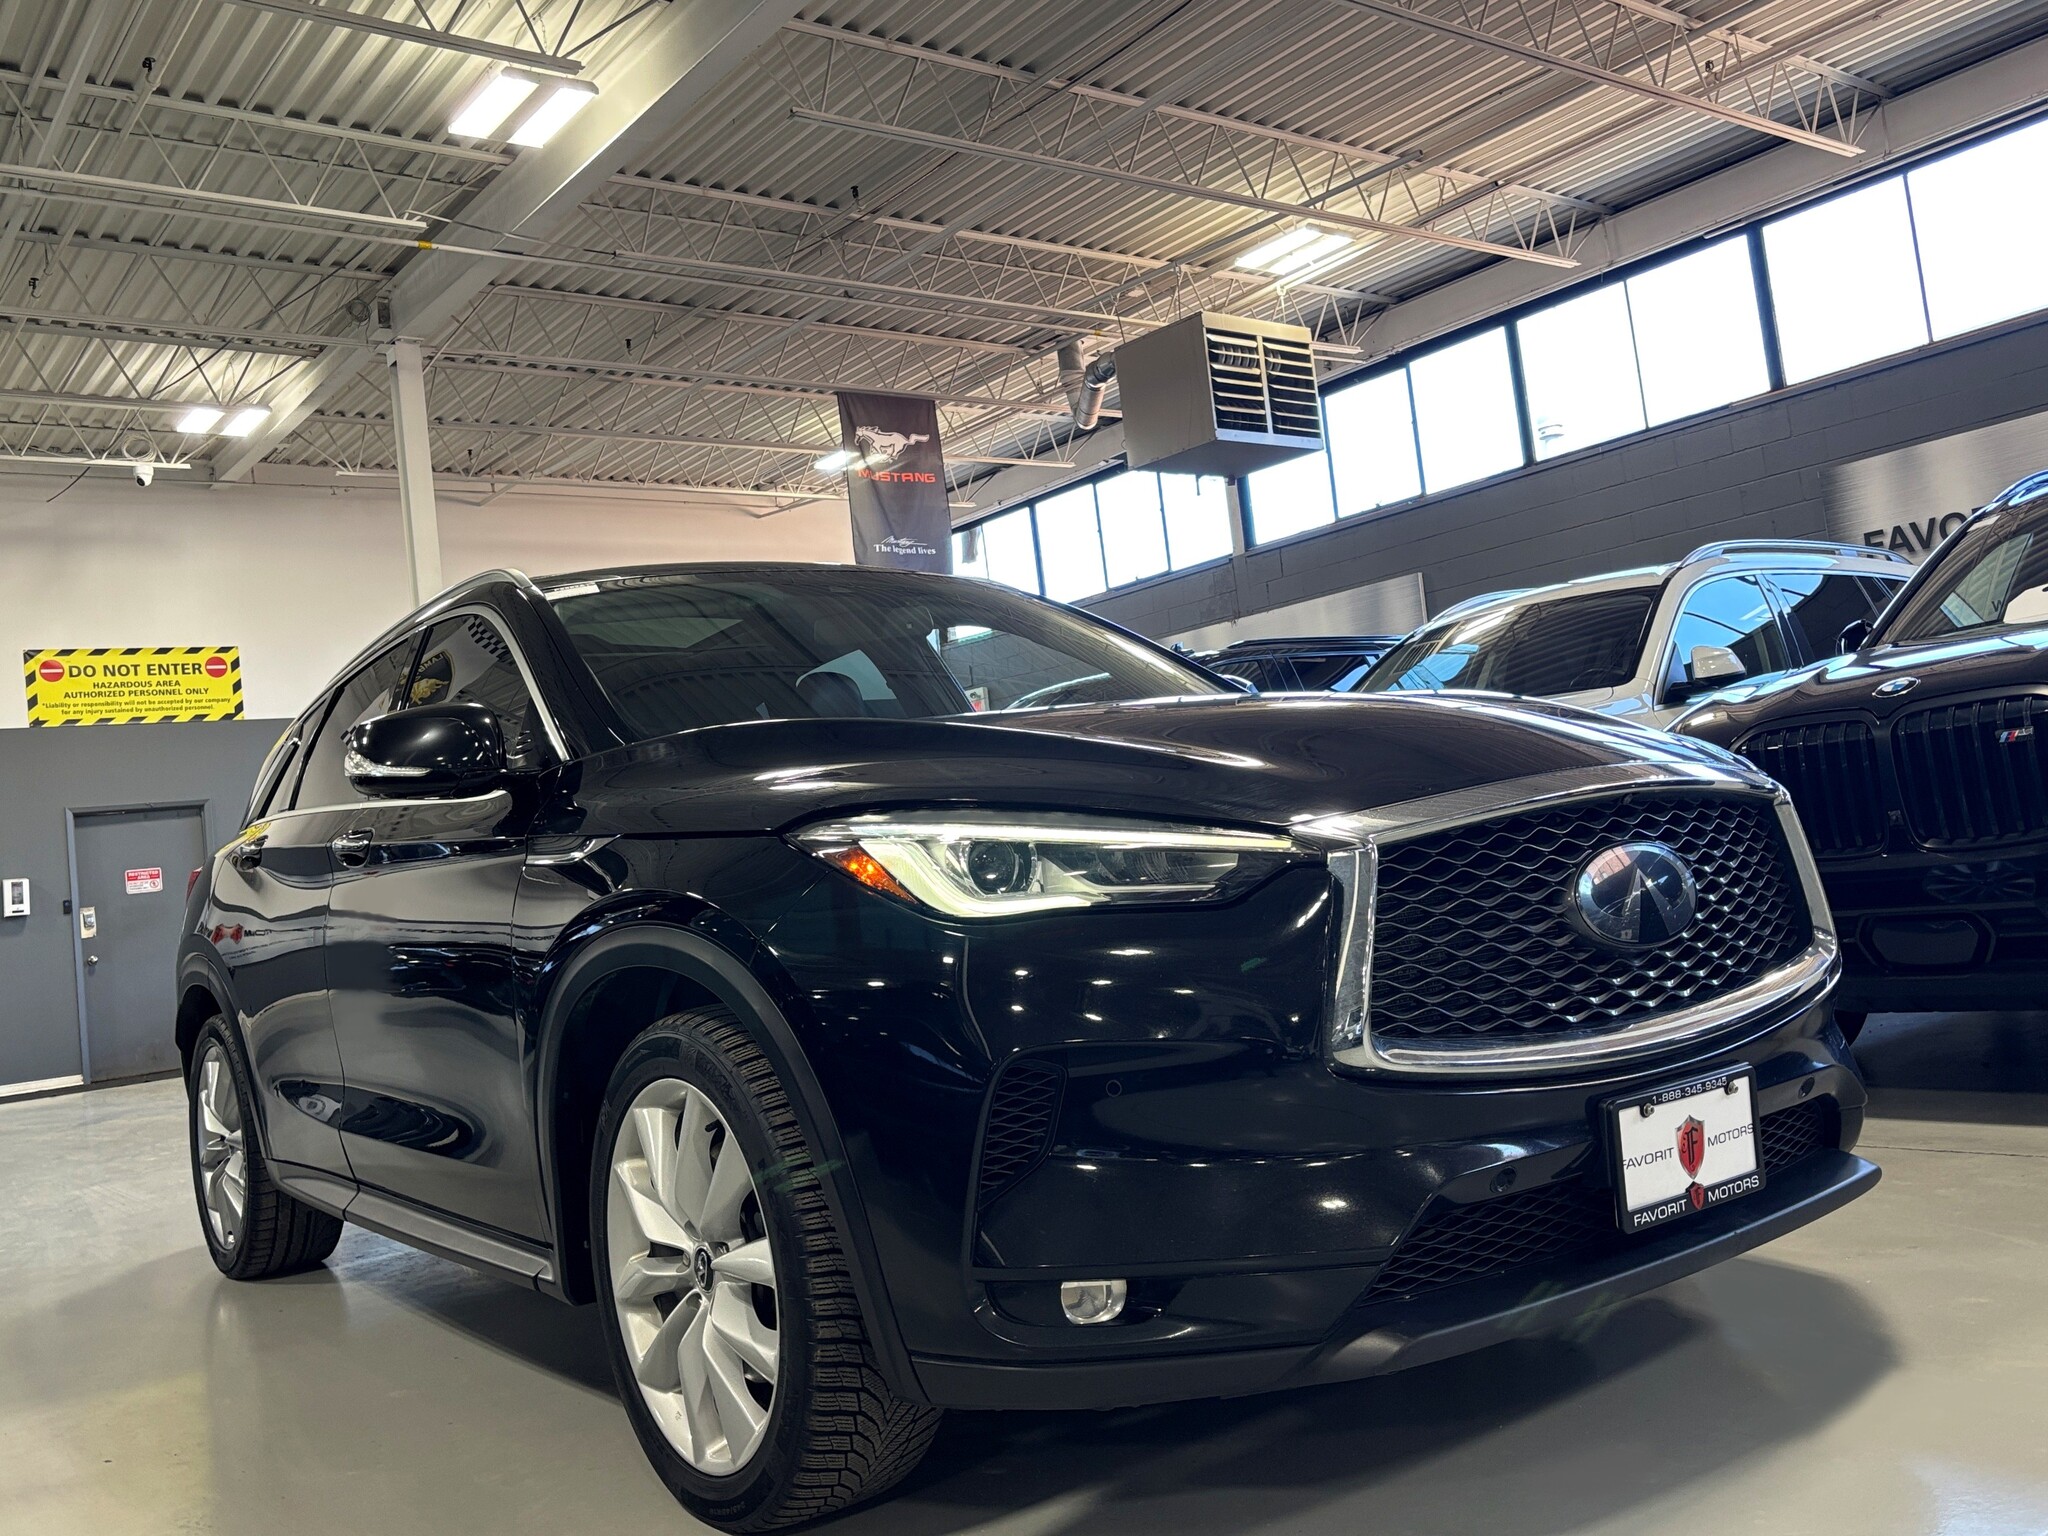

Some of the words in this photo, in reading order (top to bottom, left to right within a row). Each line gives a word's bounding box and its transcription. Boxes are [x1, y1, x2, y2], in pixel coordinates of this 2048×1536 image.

[858, 469, 936, 483] MUSTANG
[1864, 506, 1986, 558] FAVO
[873, 544, 892, 552] The
[892, 545, 916, 555] legend
[68, 665, 97, 678] DO
[103, 664, 140, 677] NOT
[146, 663, 203, 676] ENTER
[93, 681, 153, 689] HAZARDOUS
[64, 690, 126, 699] AUTHORIZED
[128, 688, 183, 697] PERSONNEL
[81, 700, 122, 708] responsibility
[157, 698, 183, 706] accepted
[1652, 1077, 1728, 1104] 1-888-345-9345
[1707, 1123, 1754, 1147] MOTORS
[1633, 1199, 1687, 1226] FAVORIT
[1707, 1175, 1760, 1203] MOTORS
